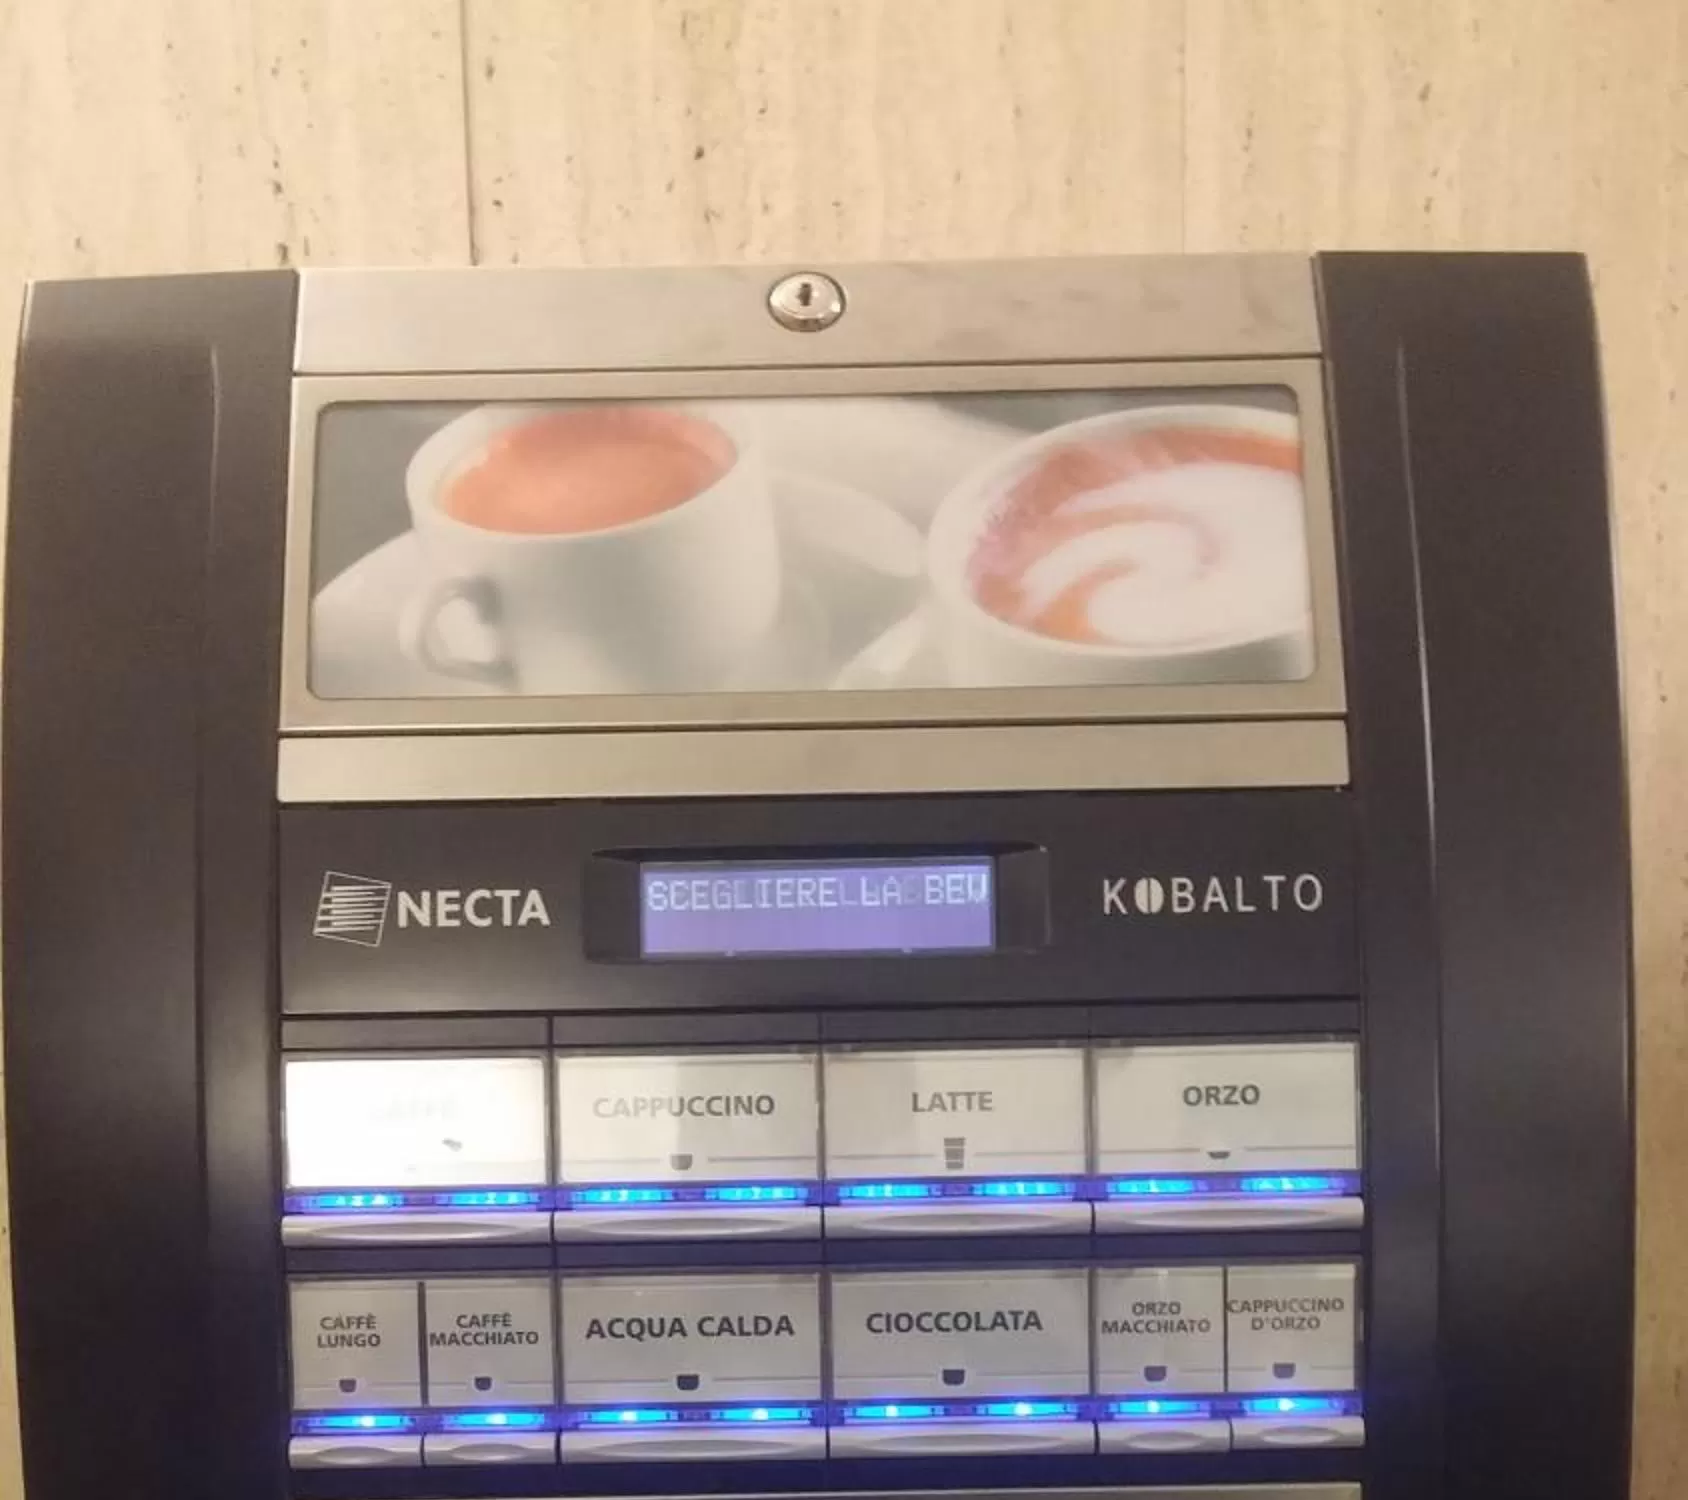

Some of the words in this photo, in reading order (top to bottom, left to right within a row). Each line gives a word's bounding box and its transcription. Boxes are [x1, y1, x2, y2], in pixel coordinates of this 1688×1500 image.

[648, 876, 838, 911] SCEGLIERE
[860, 875, 902, 906] LA
[1102, 873, 1323, 915] KOBALTO
[397, 889, 552, 928] NECTA
[592, 1094, 775, 1119] CAPPUCCINO
[912, 1090, 994, 1114] LATTE
[1182, 1083, 1261, 1107] ORZO
[1131, 1301, 1181, 1317] ORZO
[1226, 1298, 1345, 1314] CAPPUCCINO
[585, 1316, 688, 1342] ACQUA
[697, 1314, 796, 1338] CALDA
[865, 1309, 1044, 1333] CIOCCOLATA
[1101, 1318, 1212, 1334] MACCHIATO
[1251, 1316, 1321, 1331] D'ORZO
[316, 1333, 382, 1348] LUNGO
[429, 1331, 540, 1346] MACCHIATO
